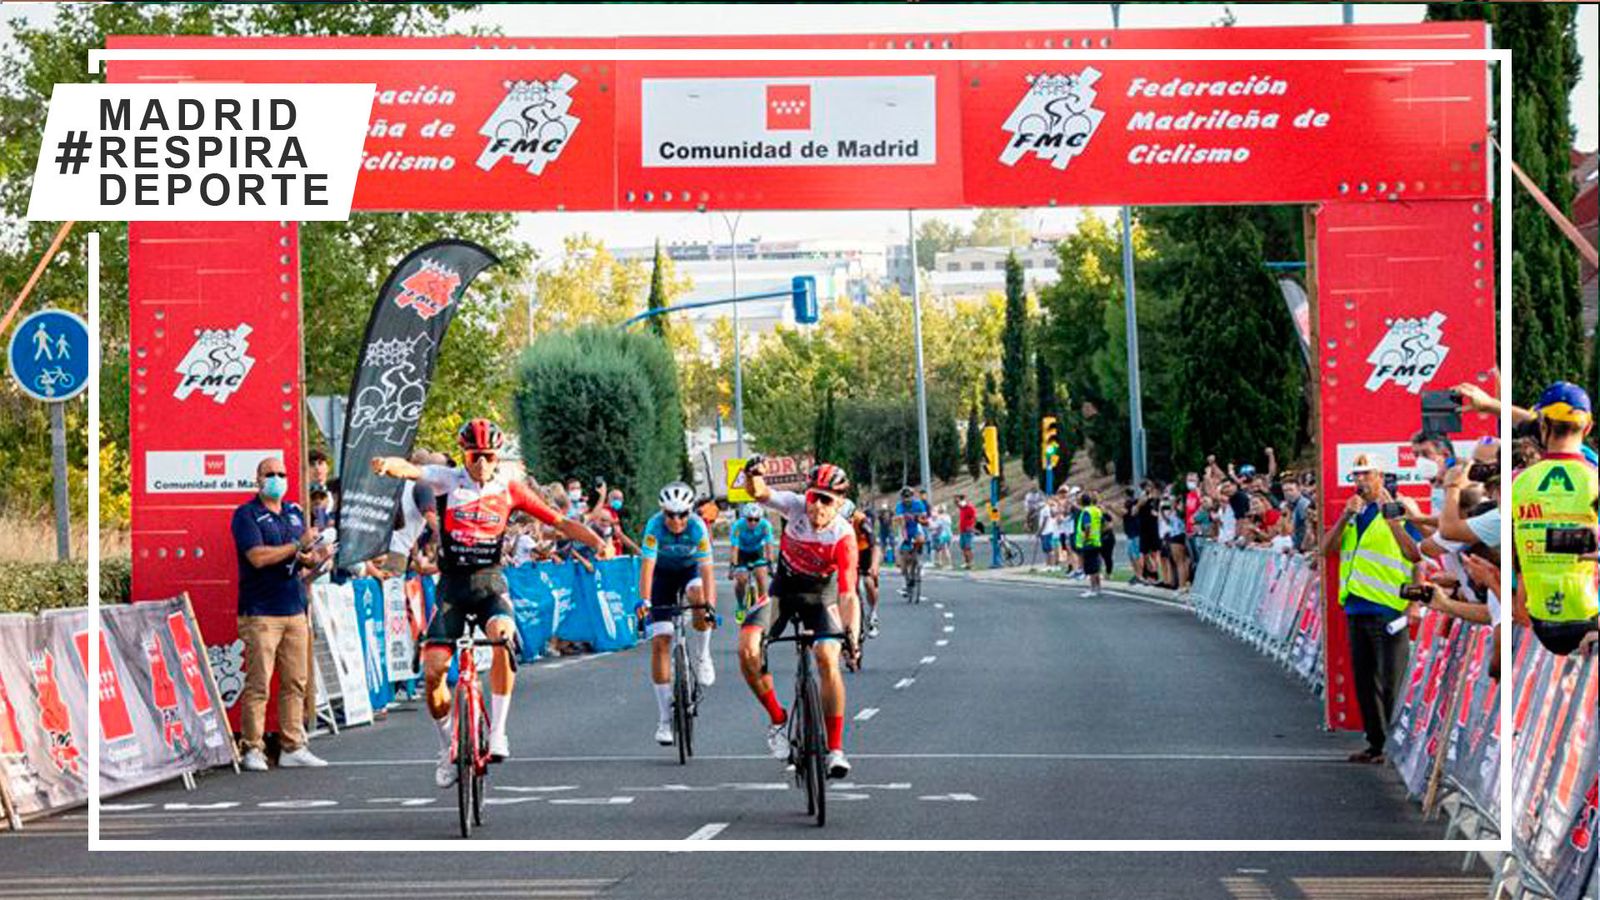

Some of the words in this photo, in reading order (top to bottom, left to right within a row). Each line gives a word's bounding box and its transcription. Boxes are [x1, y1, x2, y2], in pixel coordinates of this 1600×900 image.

[1127, 76, 1288, 98] Federación
[420, 118, 456, 138] de
[1126, 109, 1279, 131] Madrileña
[1293, 109, 1331, 128] de
[490, 138, 563, 153] FMC
[659, 140, 792, 160] Comunidad
[800, 140, 829, 158] de
[837, 139, 919, 158] Madrid
[1013, 132, 1087, 148] FMC
[1127, 144, 1251, 165] Ciclismo
[184, 374, 241, 387] FMC
[1377, 364, 1436, 377] FMC
[351, 401, 424, 427] FMC
[154, 479, 216, 490] Comunidad
[220, 480, 234, 489] de
